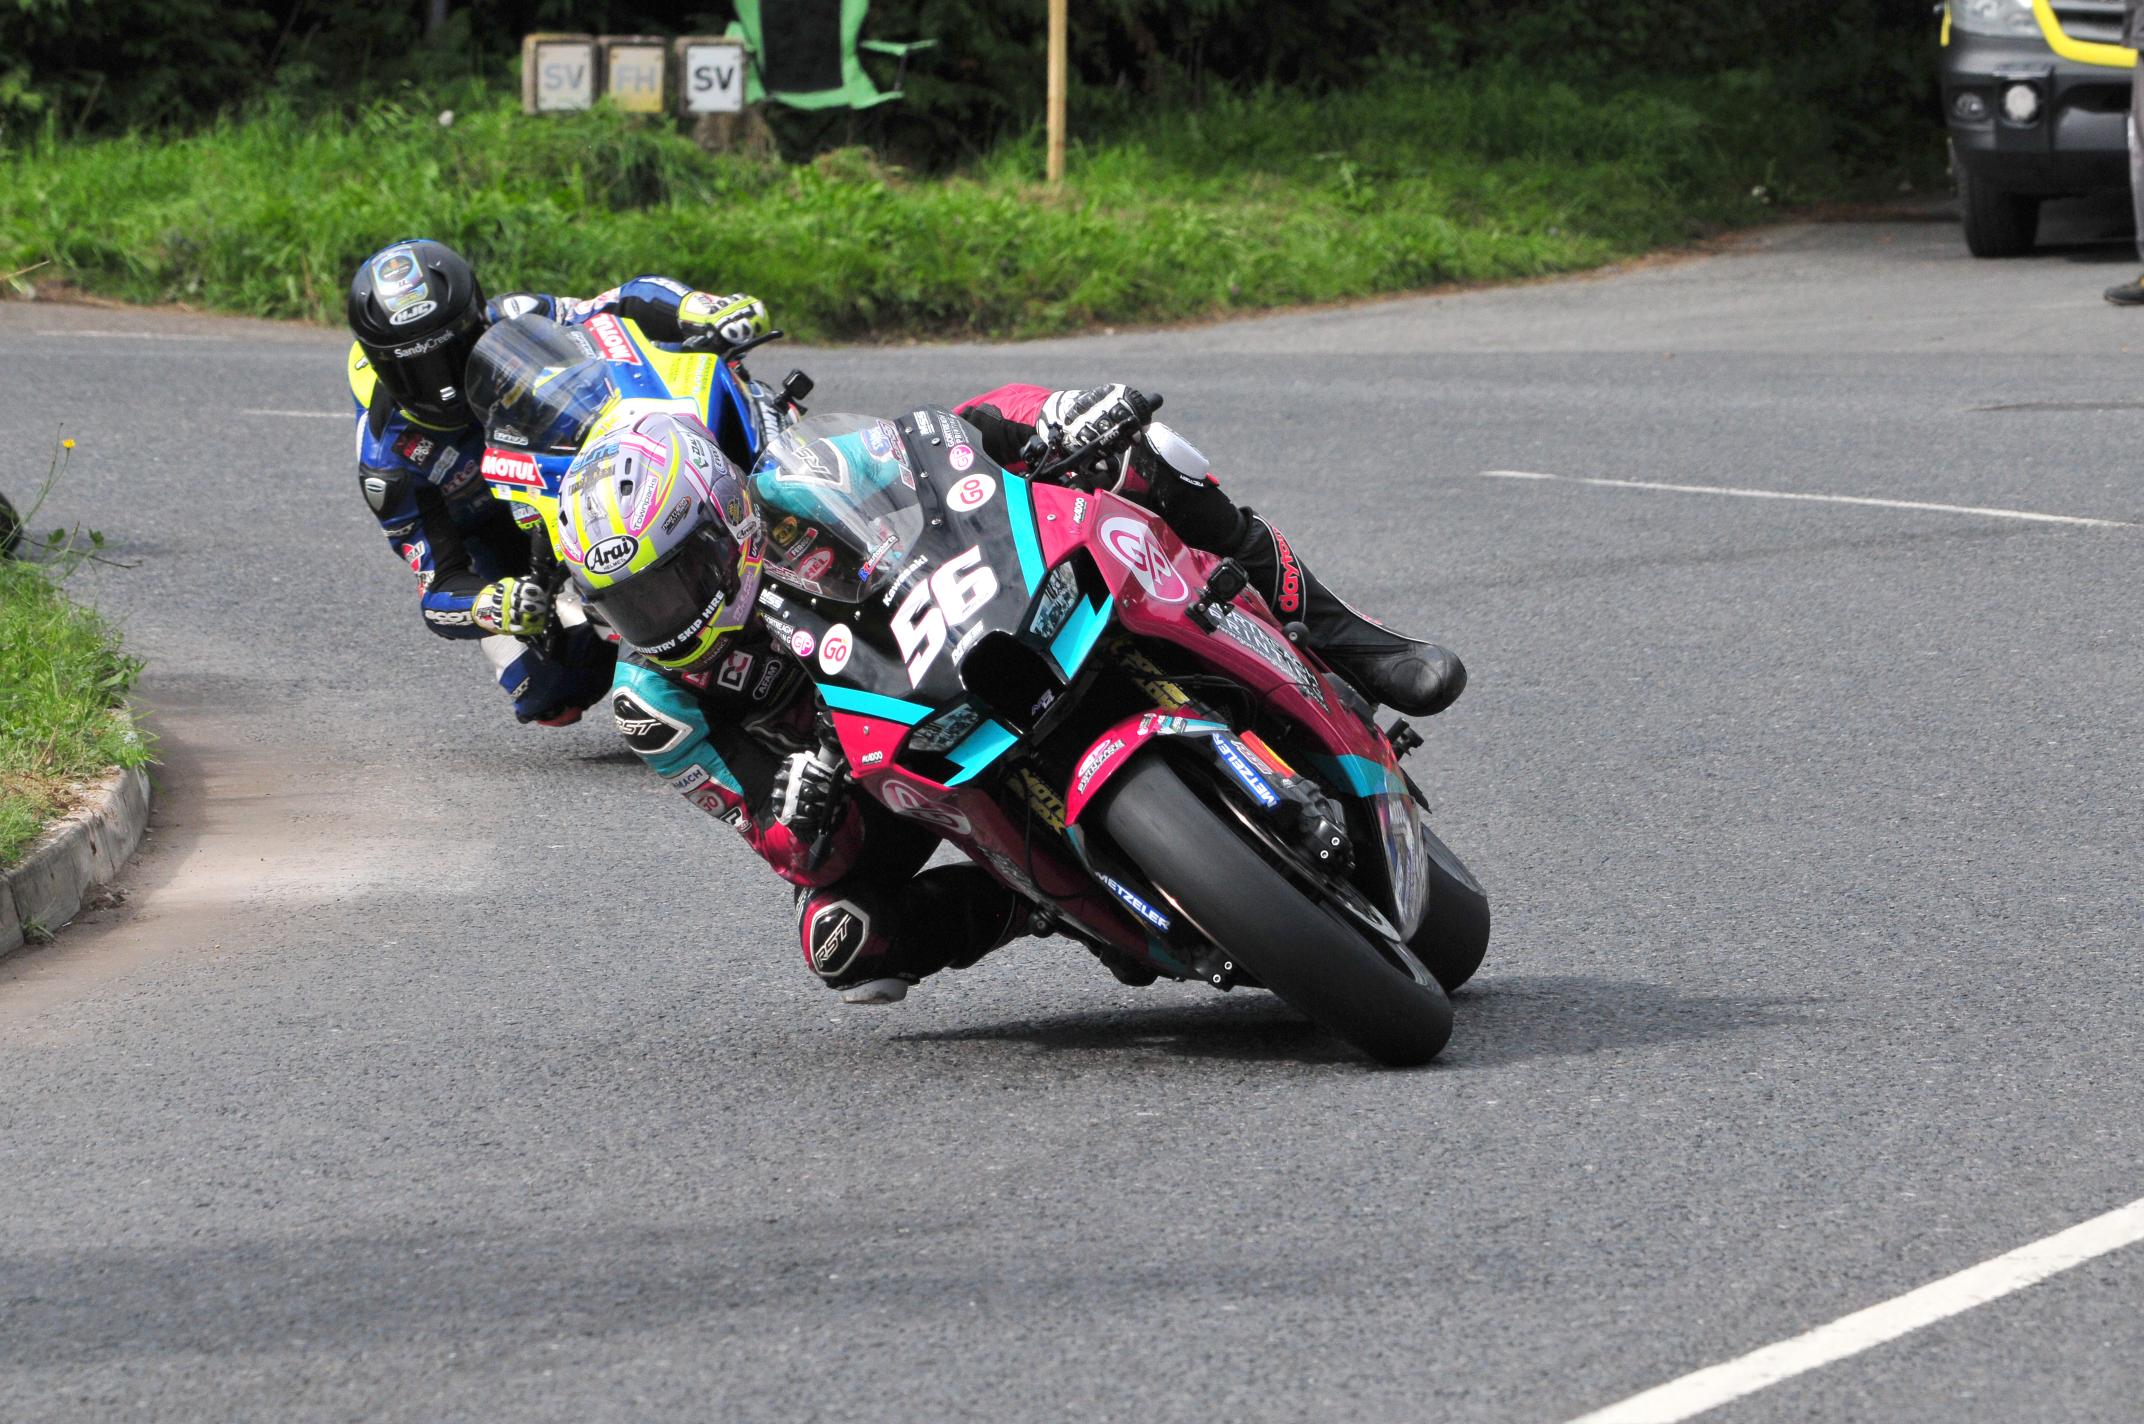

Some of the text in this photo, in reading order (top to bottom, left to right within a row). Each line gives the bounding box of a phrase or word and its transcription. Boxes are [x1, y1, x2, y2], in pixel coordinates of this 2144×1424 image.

[543, 63, 585, 91] SV
[616, 67, 656, 93] FH
[693, 65, 734, 92] SV
[592, 314, 632, 364] MOTUL
[481, 456, 537, 482] MOTUL
[959, 478, 984, 505] GO
[589, 537, 632, 569] Arai
[882, 554, 929, 608] Kawasaki
[677, 619, 704, 643] SKIP
[702, 590, 725, 618] HIRE
[890, 545, 998, 690] 56
[824, 637, 848, 662] GO
[758, 664, 778, 696] AFAM
[615, 719, 663, 736] RST
[1211, 733, 1281, 808] METZELER
[1096, 871, 1172, 932] METZELER
[815, 914, 852, 969] RST
